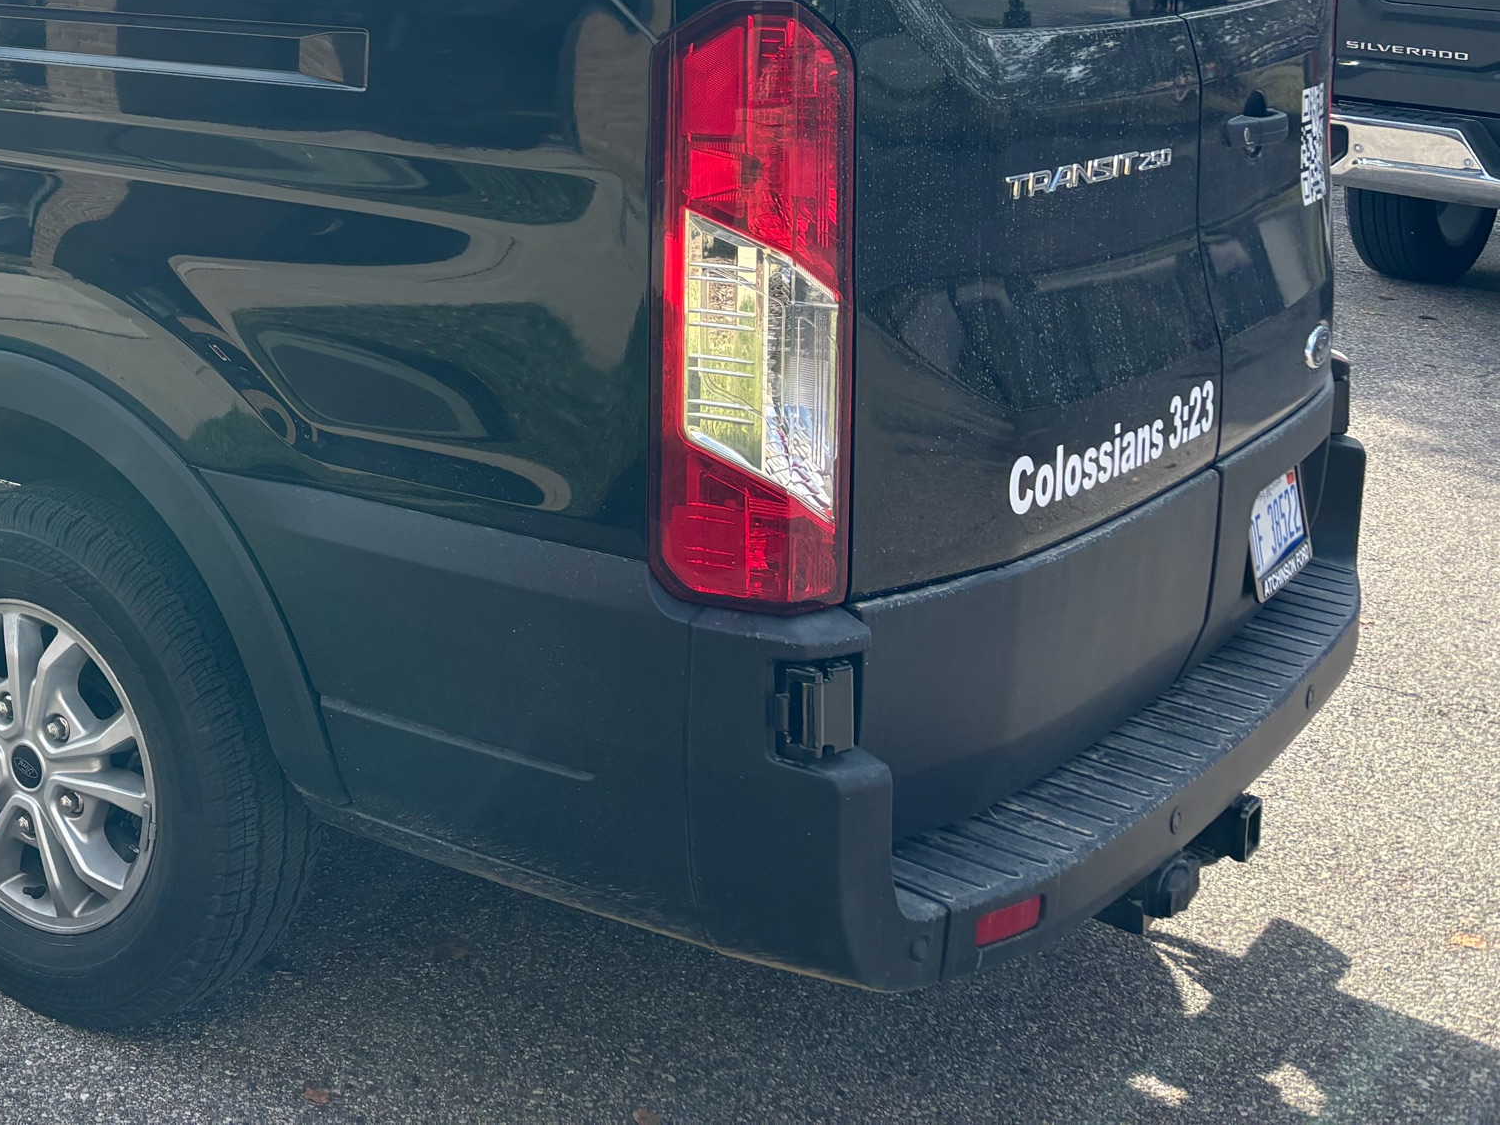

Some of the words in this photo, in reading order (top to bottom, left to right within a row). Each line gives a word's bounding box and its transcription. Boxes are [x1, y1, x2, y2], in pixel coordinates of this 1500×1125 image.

[1345, 40, 1469, 61] SILVERADO
[1005, 150, 1139, 200] TRANSIT
[1138, 147, 1173, 172] 250
[1009, 418, 1165, 516] Colossians
[1168, 380, 1215, 451] 3:23
[1266, 484, 1302, 556] 38522
[1295, 542, 1310, 569] FORD
